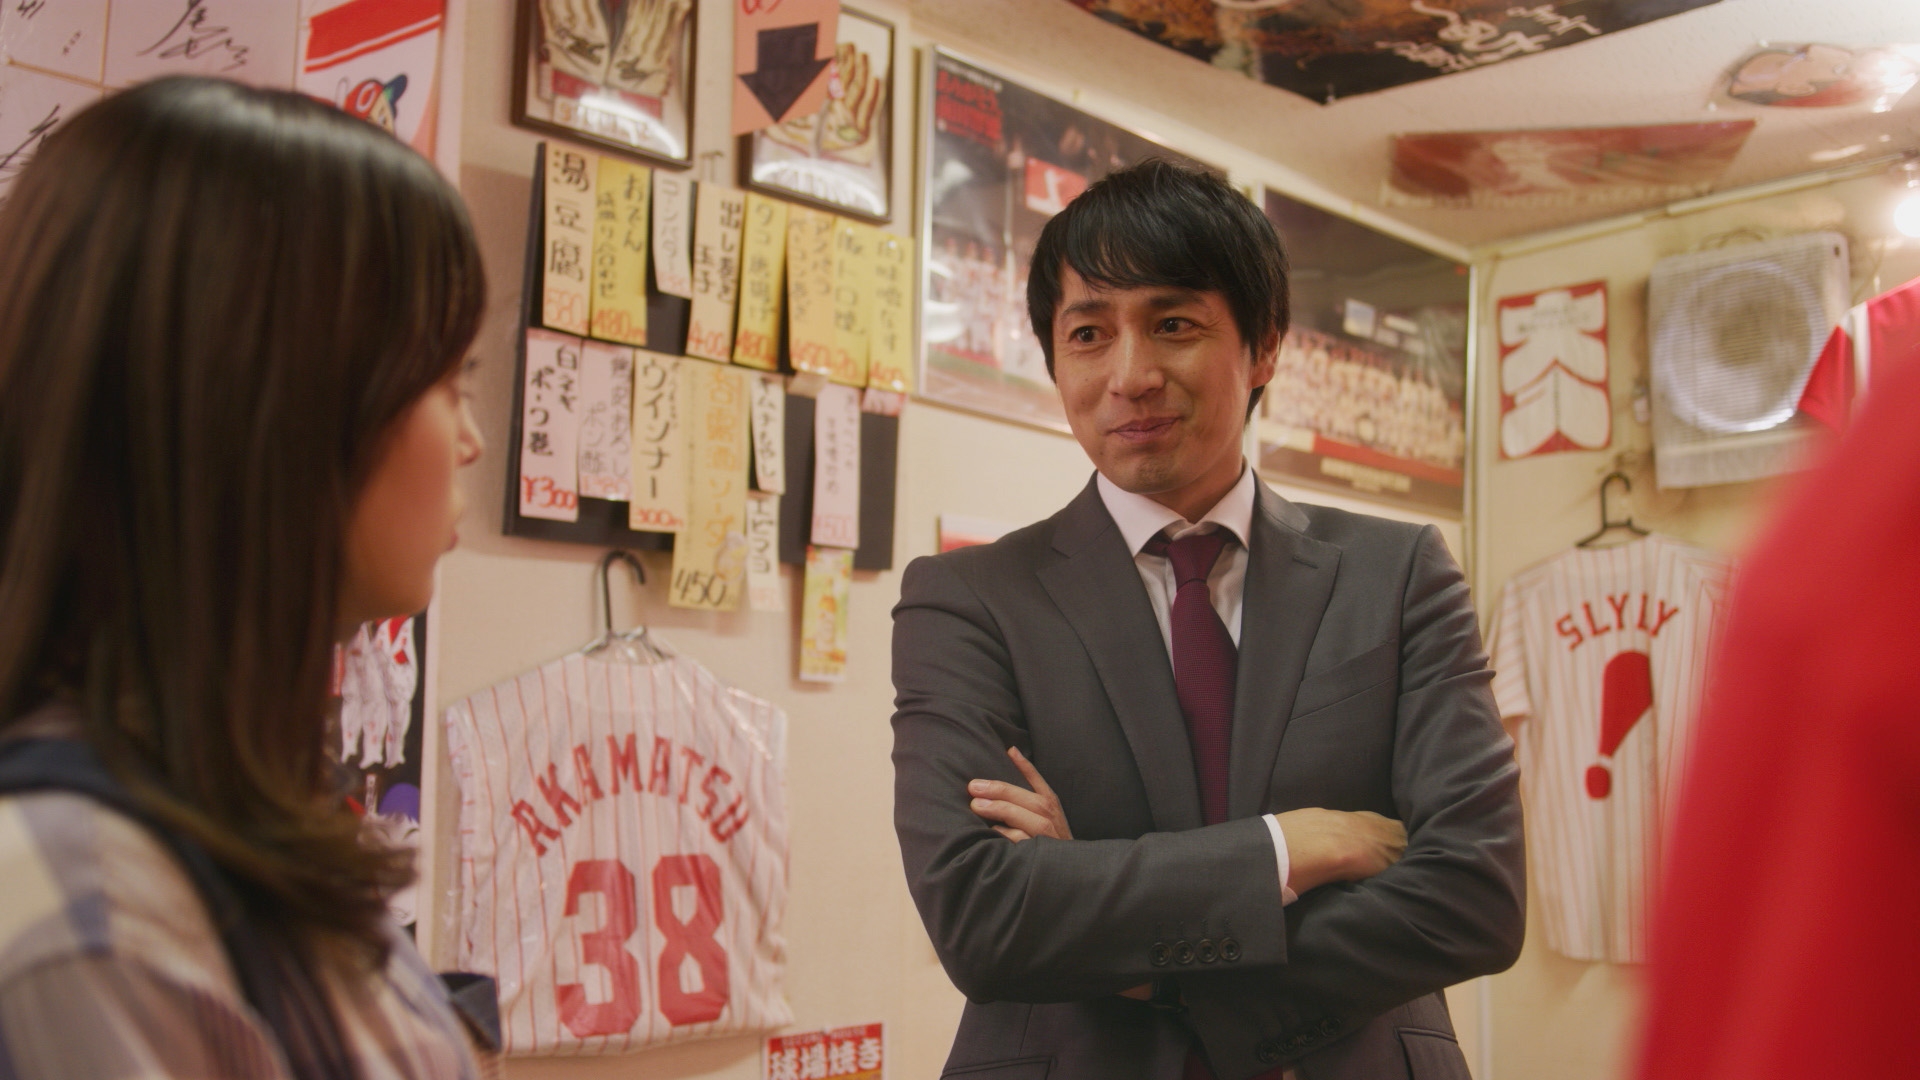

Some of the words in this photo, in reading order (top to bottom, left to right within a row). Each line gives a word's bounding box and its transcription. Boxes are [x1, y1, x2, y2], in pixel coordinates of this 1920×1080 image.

[550, 149, 590, 283] 湯豆腐
[623, 172, 644, 254] おでん
[1556, 593, 1679, 650] SLYLY
[511, 733, 750, 856] AKAMATSU
[557, 853, 731, 1039] 38
[769, 1037, 881, 1080] 球場焼き
